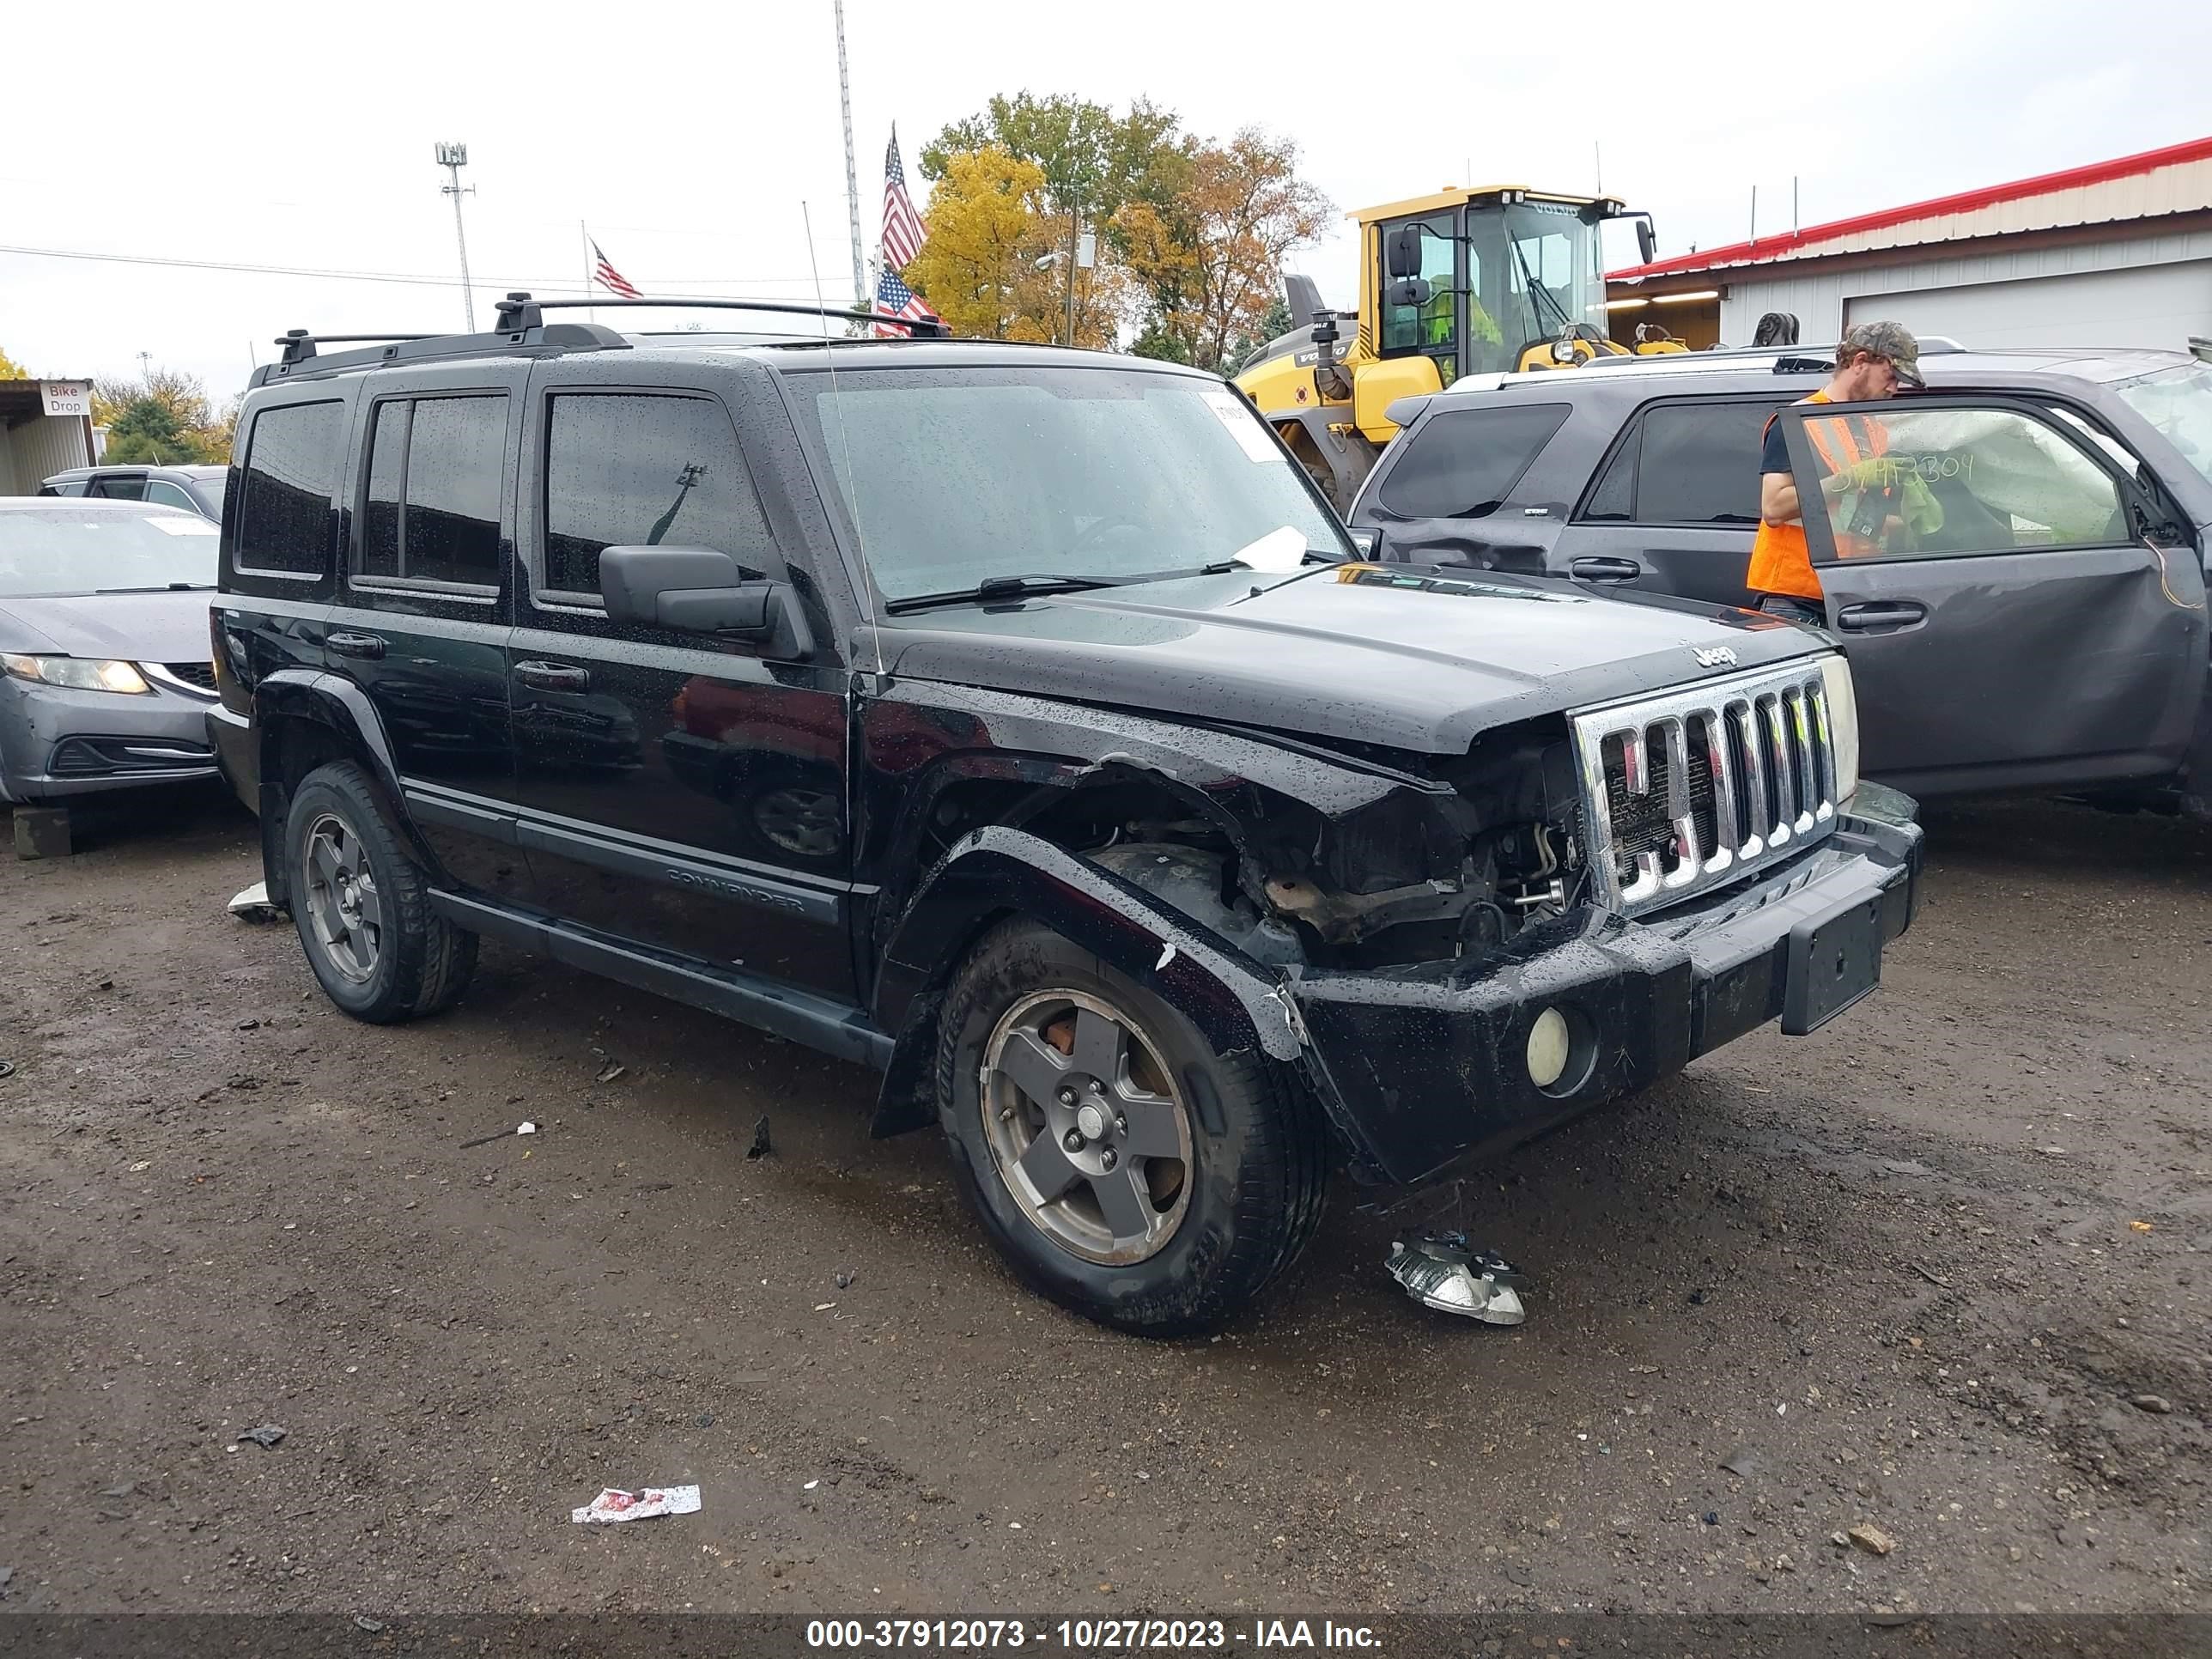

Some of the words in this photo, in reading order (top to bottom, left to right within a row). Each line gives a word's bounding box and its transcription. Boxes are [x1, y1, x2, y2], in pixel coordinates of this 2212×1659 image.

[50, 386, 78, 397] Bike
[52, 401, 81, 412] Drop
[1692, 646, 1738, 667] Jeep
